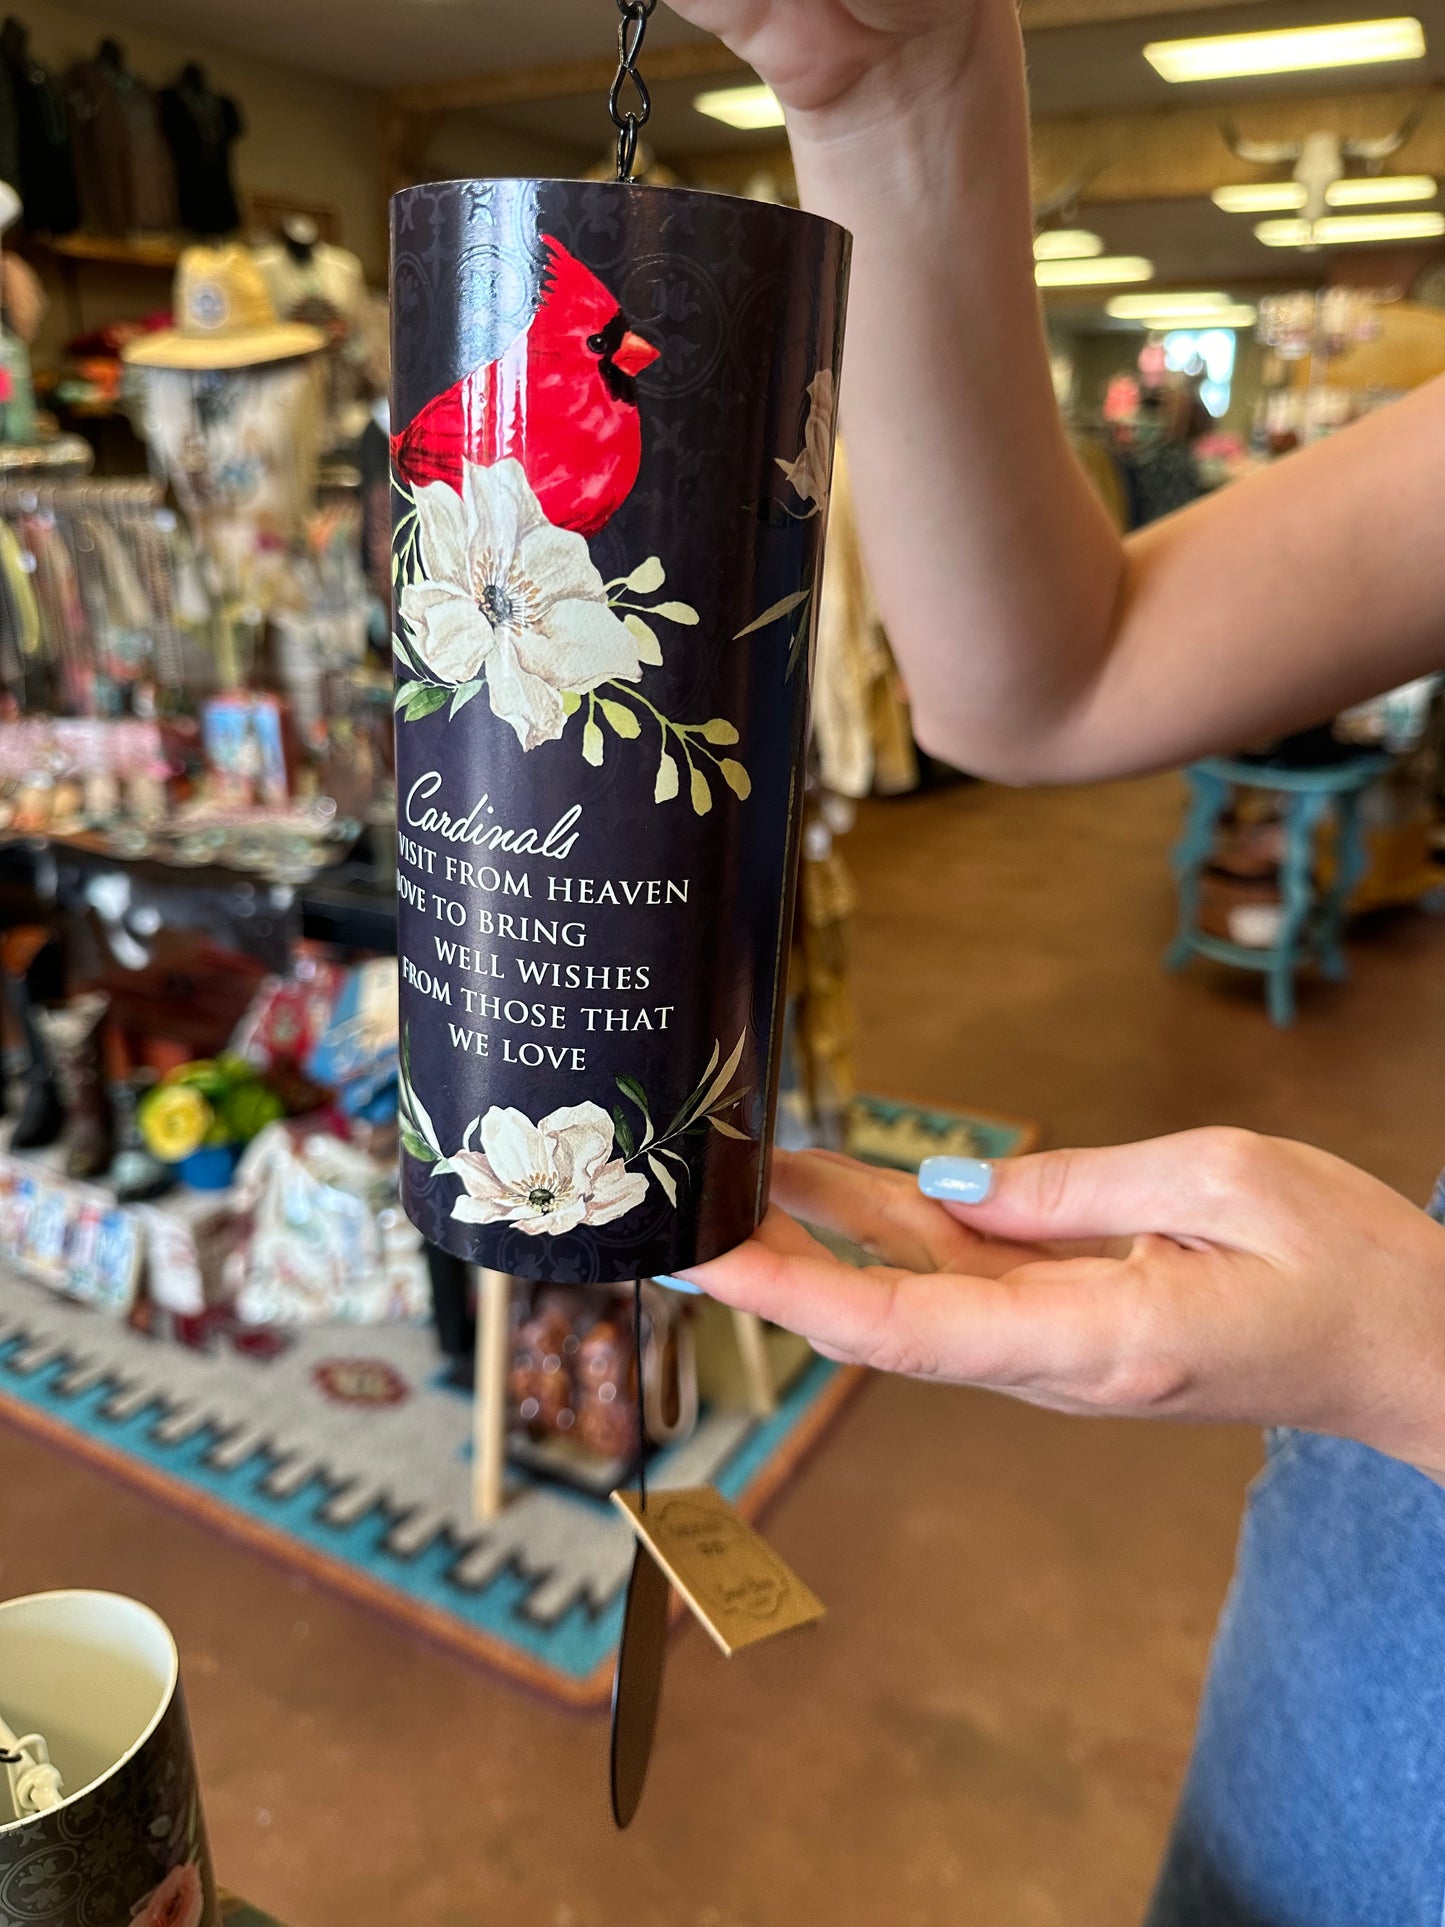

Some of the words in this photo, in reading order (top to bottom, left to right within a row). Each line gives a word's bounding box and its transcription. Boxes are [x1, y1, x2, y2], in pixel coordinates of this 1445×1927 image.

[406, 771, 583, 859] Cardinals
[398, 830, 437, 875] VISIT
[445, 856, 532, 898] FROM
[547, 876, 690, 905] HEAVEN
[432, 894, 467, 927] TO
[478, 909, 587, 947] BRING
[402, 956, 452, 1006] FROM
[460, 988, 566, 1029] THOSE
[580, 1006, 674, 1032] THAT
[434, 936, 505, 979] WELL
[516, 958, 650, 990] WISHES
[448, 1023, 489, 1057] WE
[502, 1039, 586, 1071] LOVE
